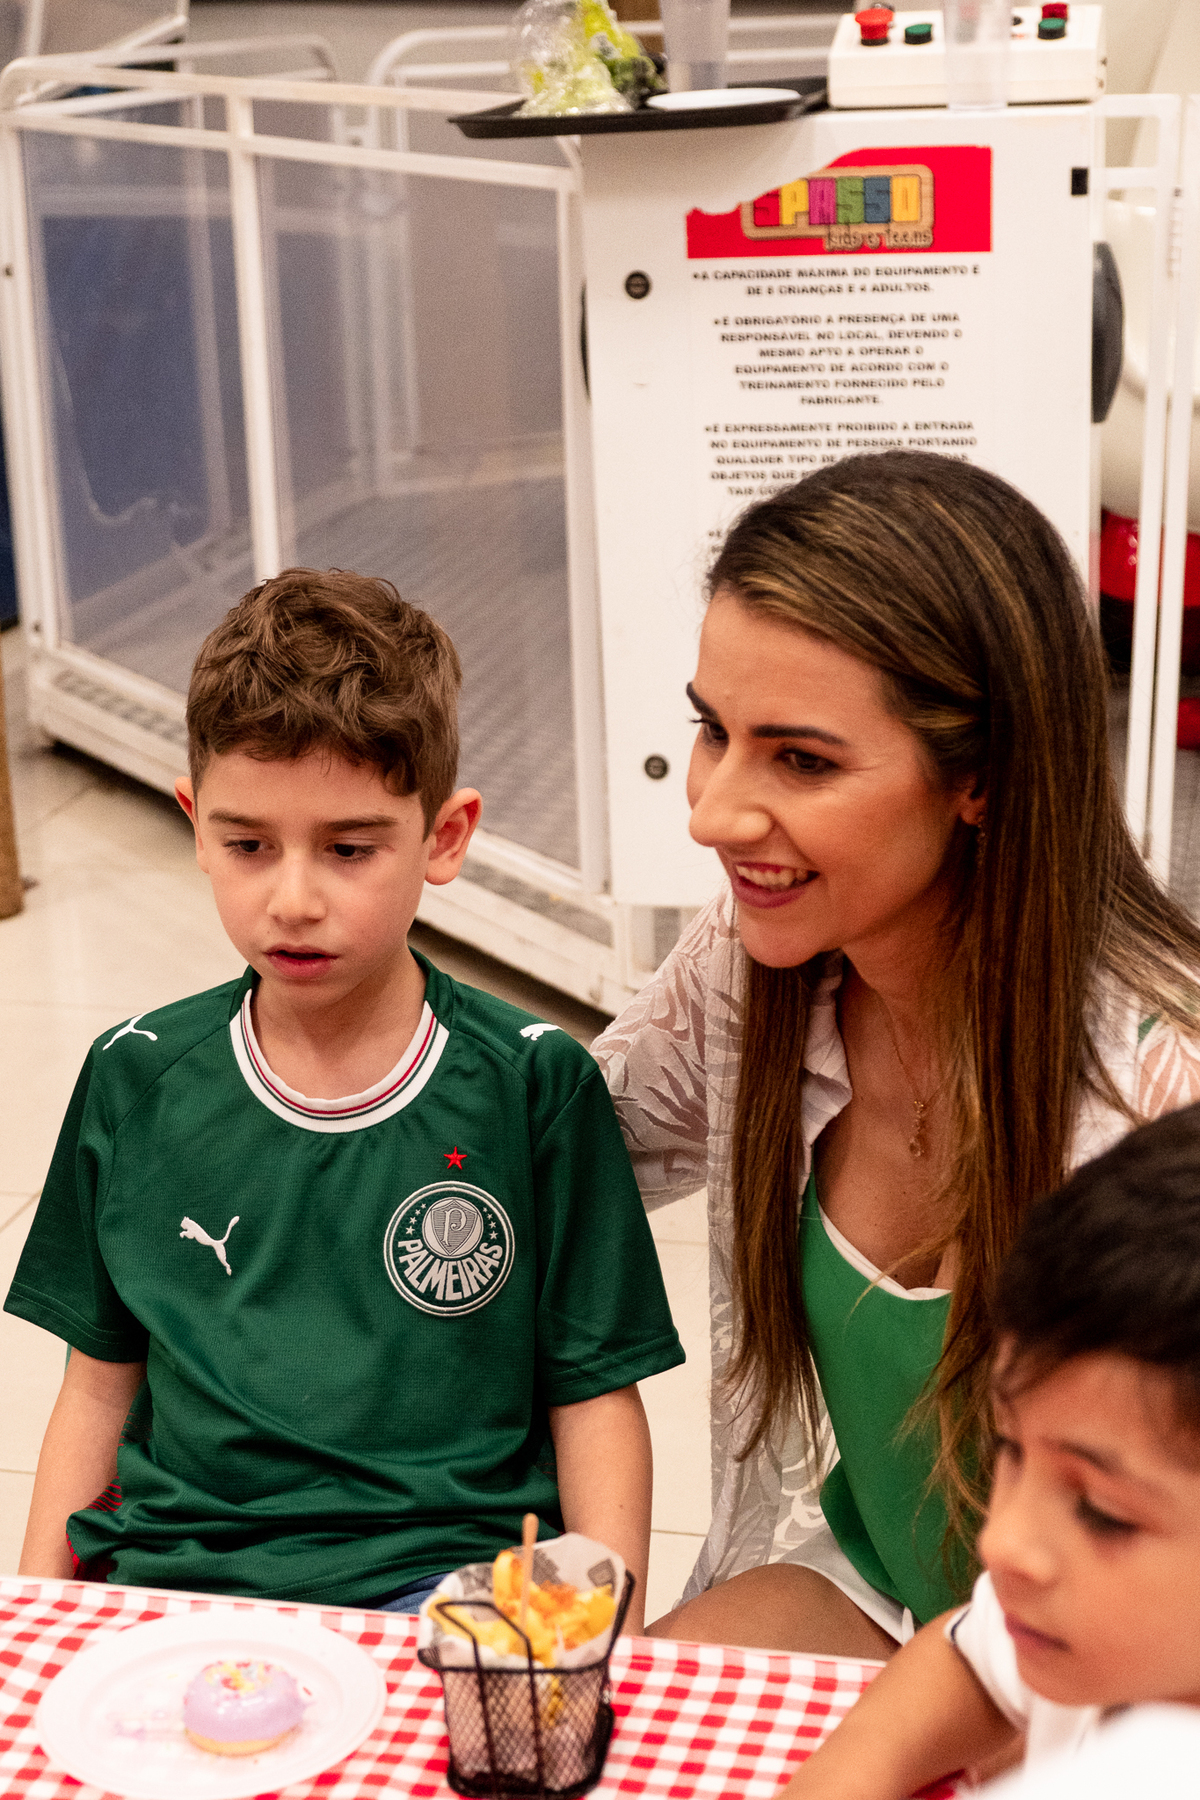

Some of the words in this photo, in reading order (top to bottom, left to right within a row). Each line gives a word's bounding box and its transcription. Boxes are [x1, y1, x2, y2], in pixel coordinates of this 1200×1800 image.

[754, 176, 917, 227] SPASSO
[713, 268, 791, 281] CAPACIDADE
[853, 267, 871, 278] DO
[875, 265, 969, 278] EQUIPAMENTO
[746, 286, 762, 298] DE
[778, 284, 844, 299] CRIANÇAS
[911, 312, 926, 324] DE
[931, 312, 960, 324] UMA
[816, 331, 836, 343] NO
[888, 329, 951, 341] DEVENDO
[759, 348, 804, 360] MESMO
[809, 347, 841, 359] APTO
[858, 346, 910, 358] OPERAR
[734, 363, 824, 376] EQUIPAMENTO
[830, 363, 844, 374] DE
[850, 362, 902, 374] ACORDO
[907, 361, 936, 373] COM
[739, 379, 829, 392] TREINAMENTO
[834, 378, 909, 390] FORNECIDO
[913, 377, 947, 389] PELO
[724, 422, 831, 434] EXPRESSAMENTE
[837, 422, 899, 433] PROIBIDO
[914, 421, 974, 433] ENTRADA
[710, 439, 728, 451] NO
[732, 438, 821, 451] EQUIPAMENTO
[826, 438, 841, 450] DE
[846, 437, 904, 449] PESSOAS
[908, 437, 978, 449] PORTANDO
[716, 454, 784, 466] QUALQUER
[788, 454, 818, 465] TIPO
[710, 470, 767, 482] OBJETOS
[398, 1240, 503, 1301] PALMEIRAS
